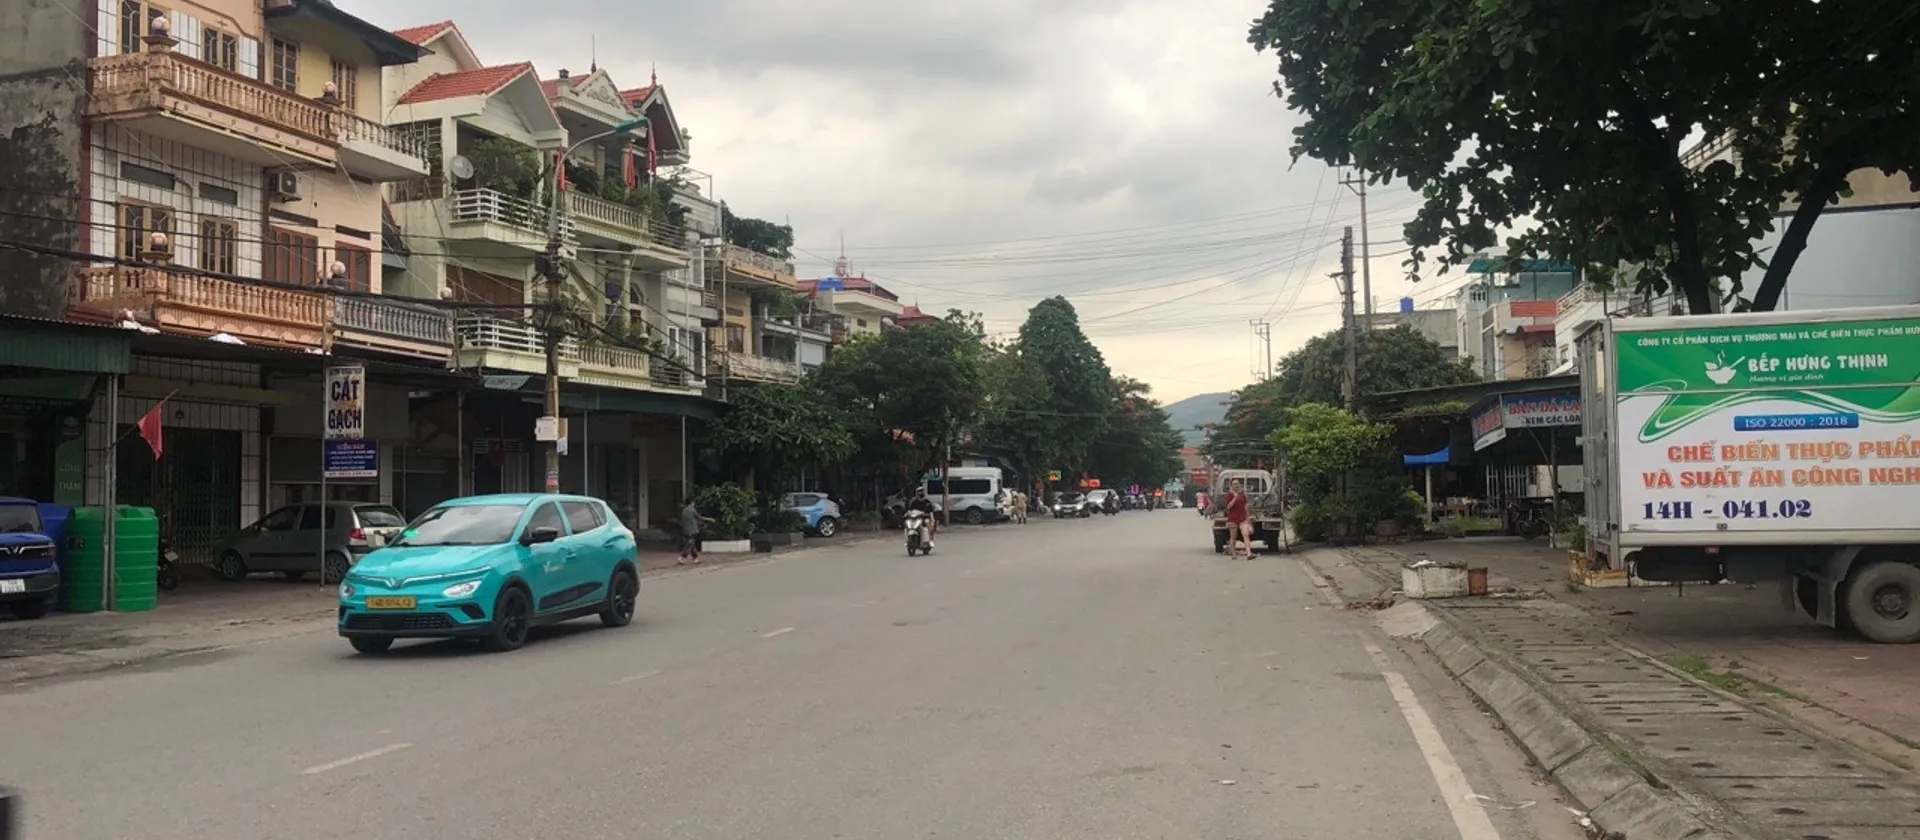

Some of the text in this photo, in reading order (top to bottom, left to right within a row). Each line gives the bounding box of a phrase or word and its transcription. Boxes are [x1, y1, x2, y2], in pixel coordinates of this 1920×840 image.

[1637, 337, 1659, 346] CÔNG
[1661, 337, 1671, 345] TY
[1710, 335, 1730, 345] DỊCH
[1748, 352, 1888, 372] BẾP HƯNG THỊNH
[329, 410, 362, 432] GẠCH
[1745, 418, 1767, 428] ISO
[1770, 417, 1806, 428] 22000
[1818, 416, 1848, 427] 2018
[1667, 440, 1717, 463] CHẾ
[1722, 439, 1780, 462] BIẾN
[1786, 440, 1852, 463] THỰC
[1641, 465, 1920, 488] VÀ SUẤT ĂN CÔNG NGH
[1642, 501, 1692, 520] 14H
[1722, 499, 1813, 519] 041.02
